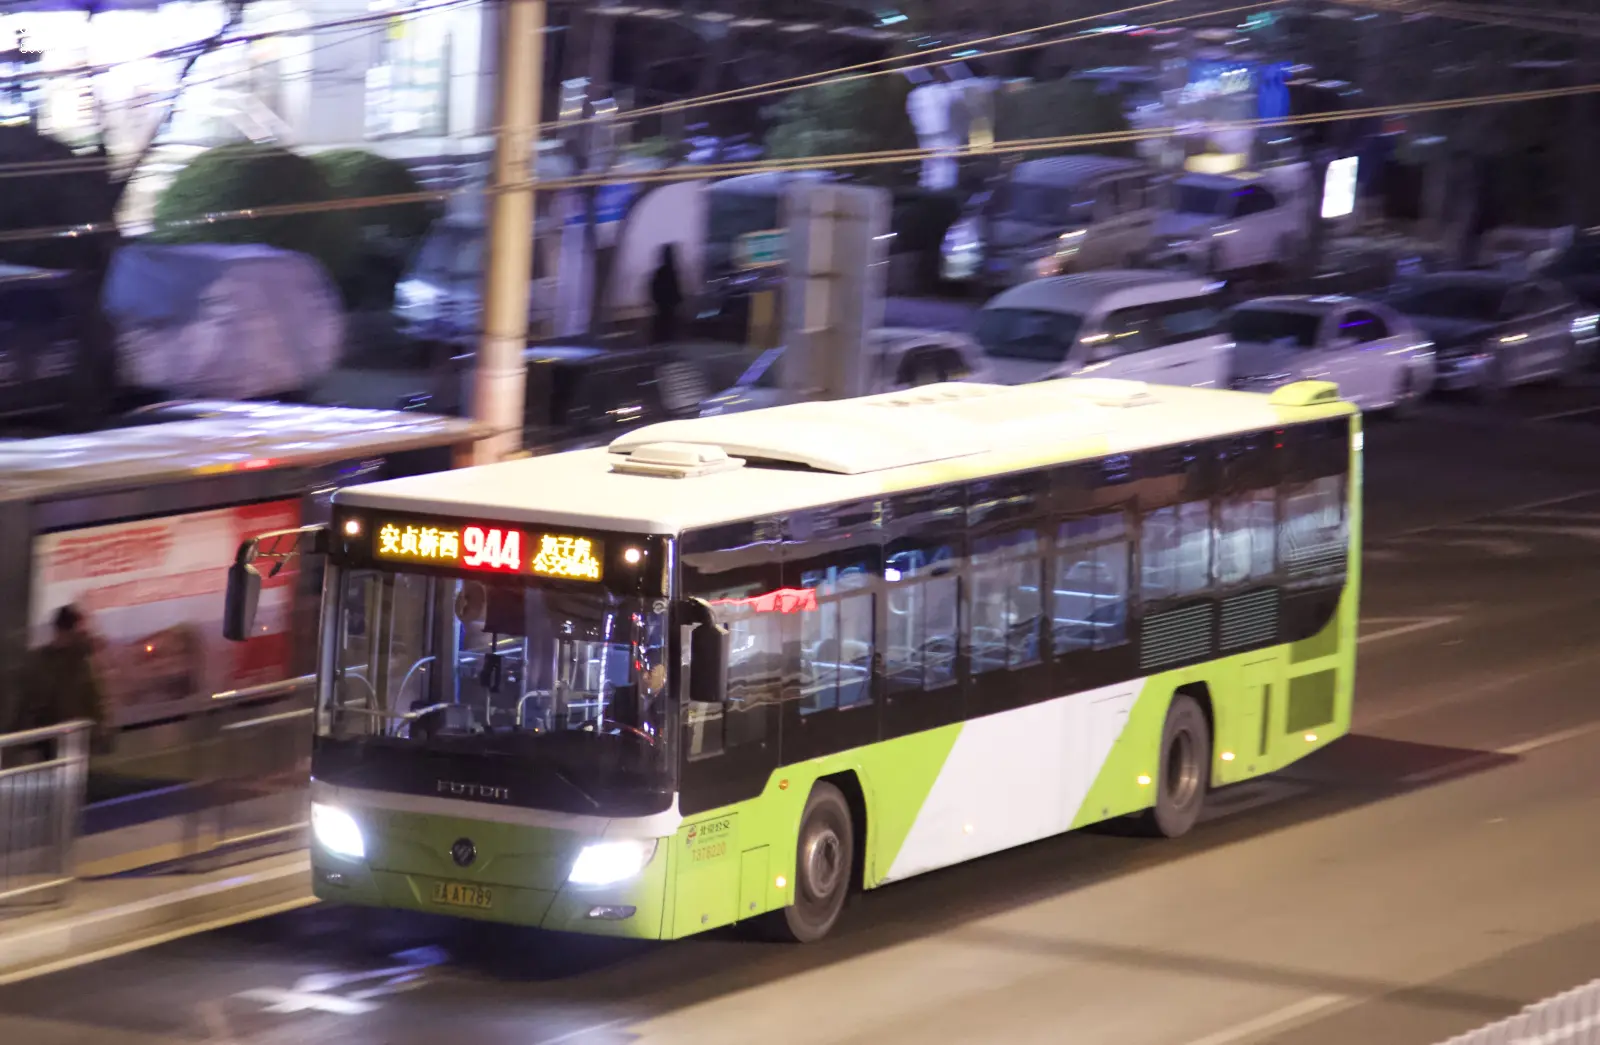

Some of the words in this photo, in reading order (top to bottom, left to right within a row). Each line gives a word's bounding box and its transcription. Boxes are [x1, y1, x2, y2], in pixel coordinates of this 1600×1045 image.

[380, 523, 459, 558] 安贞桥西
[463, 526, 520, 570] 944
